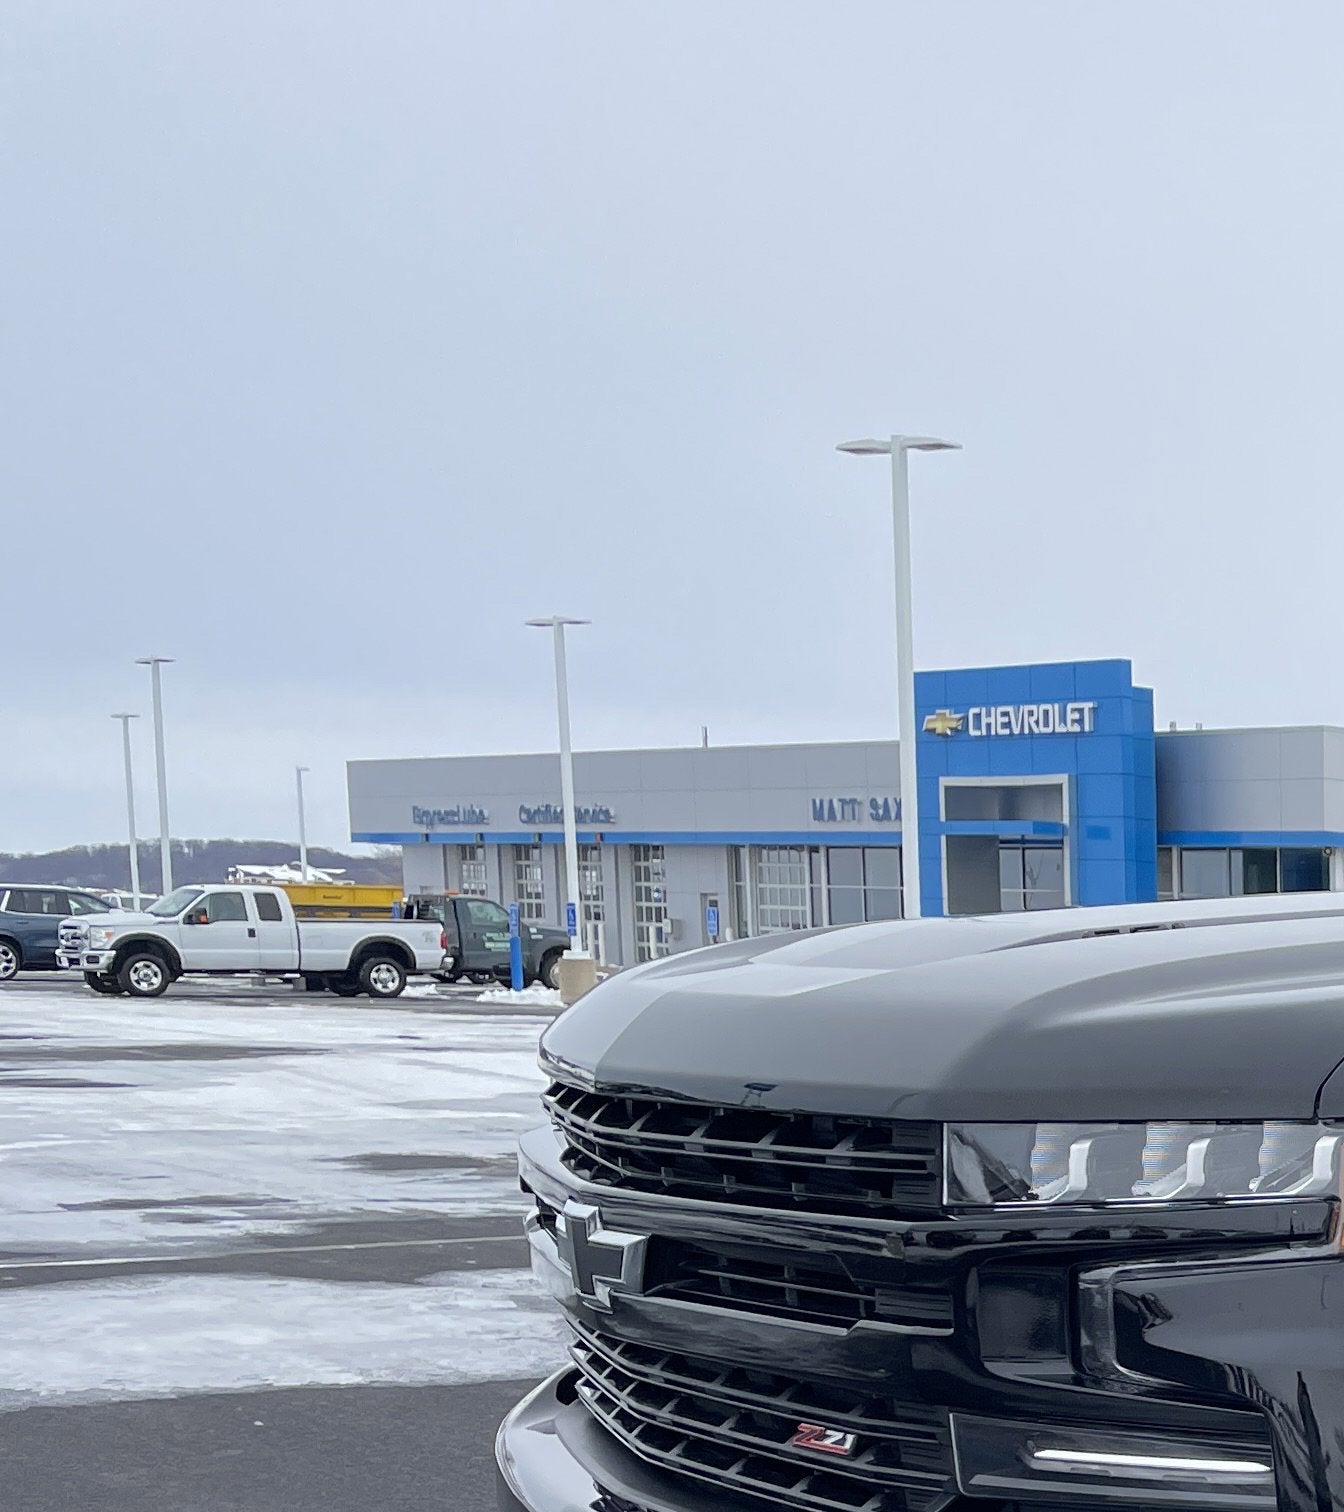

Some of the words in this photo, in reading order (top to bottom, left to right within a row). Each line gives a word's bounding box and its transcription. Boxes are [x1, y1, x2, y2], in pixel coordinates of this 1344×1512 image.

[967, 702, 1096, 736] CHEVROLET
[811, 797, 858, 822] MATT
[792, 1423, 858, 1456] Z71
